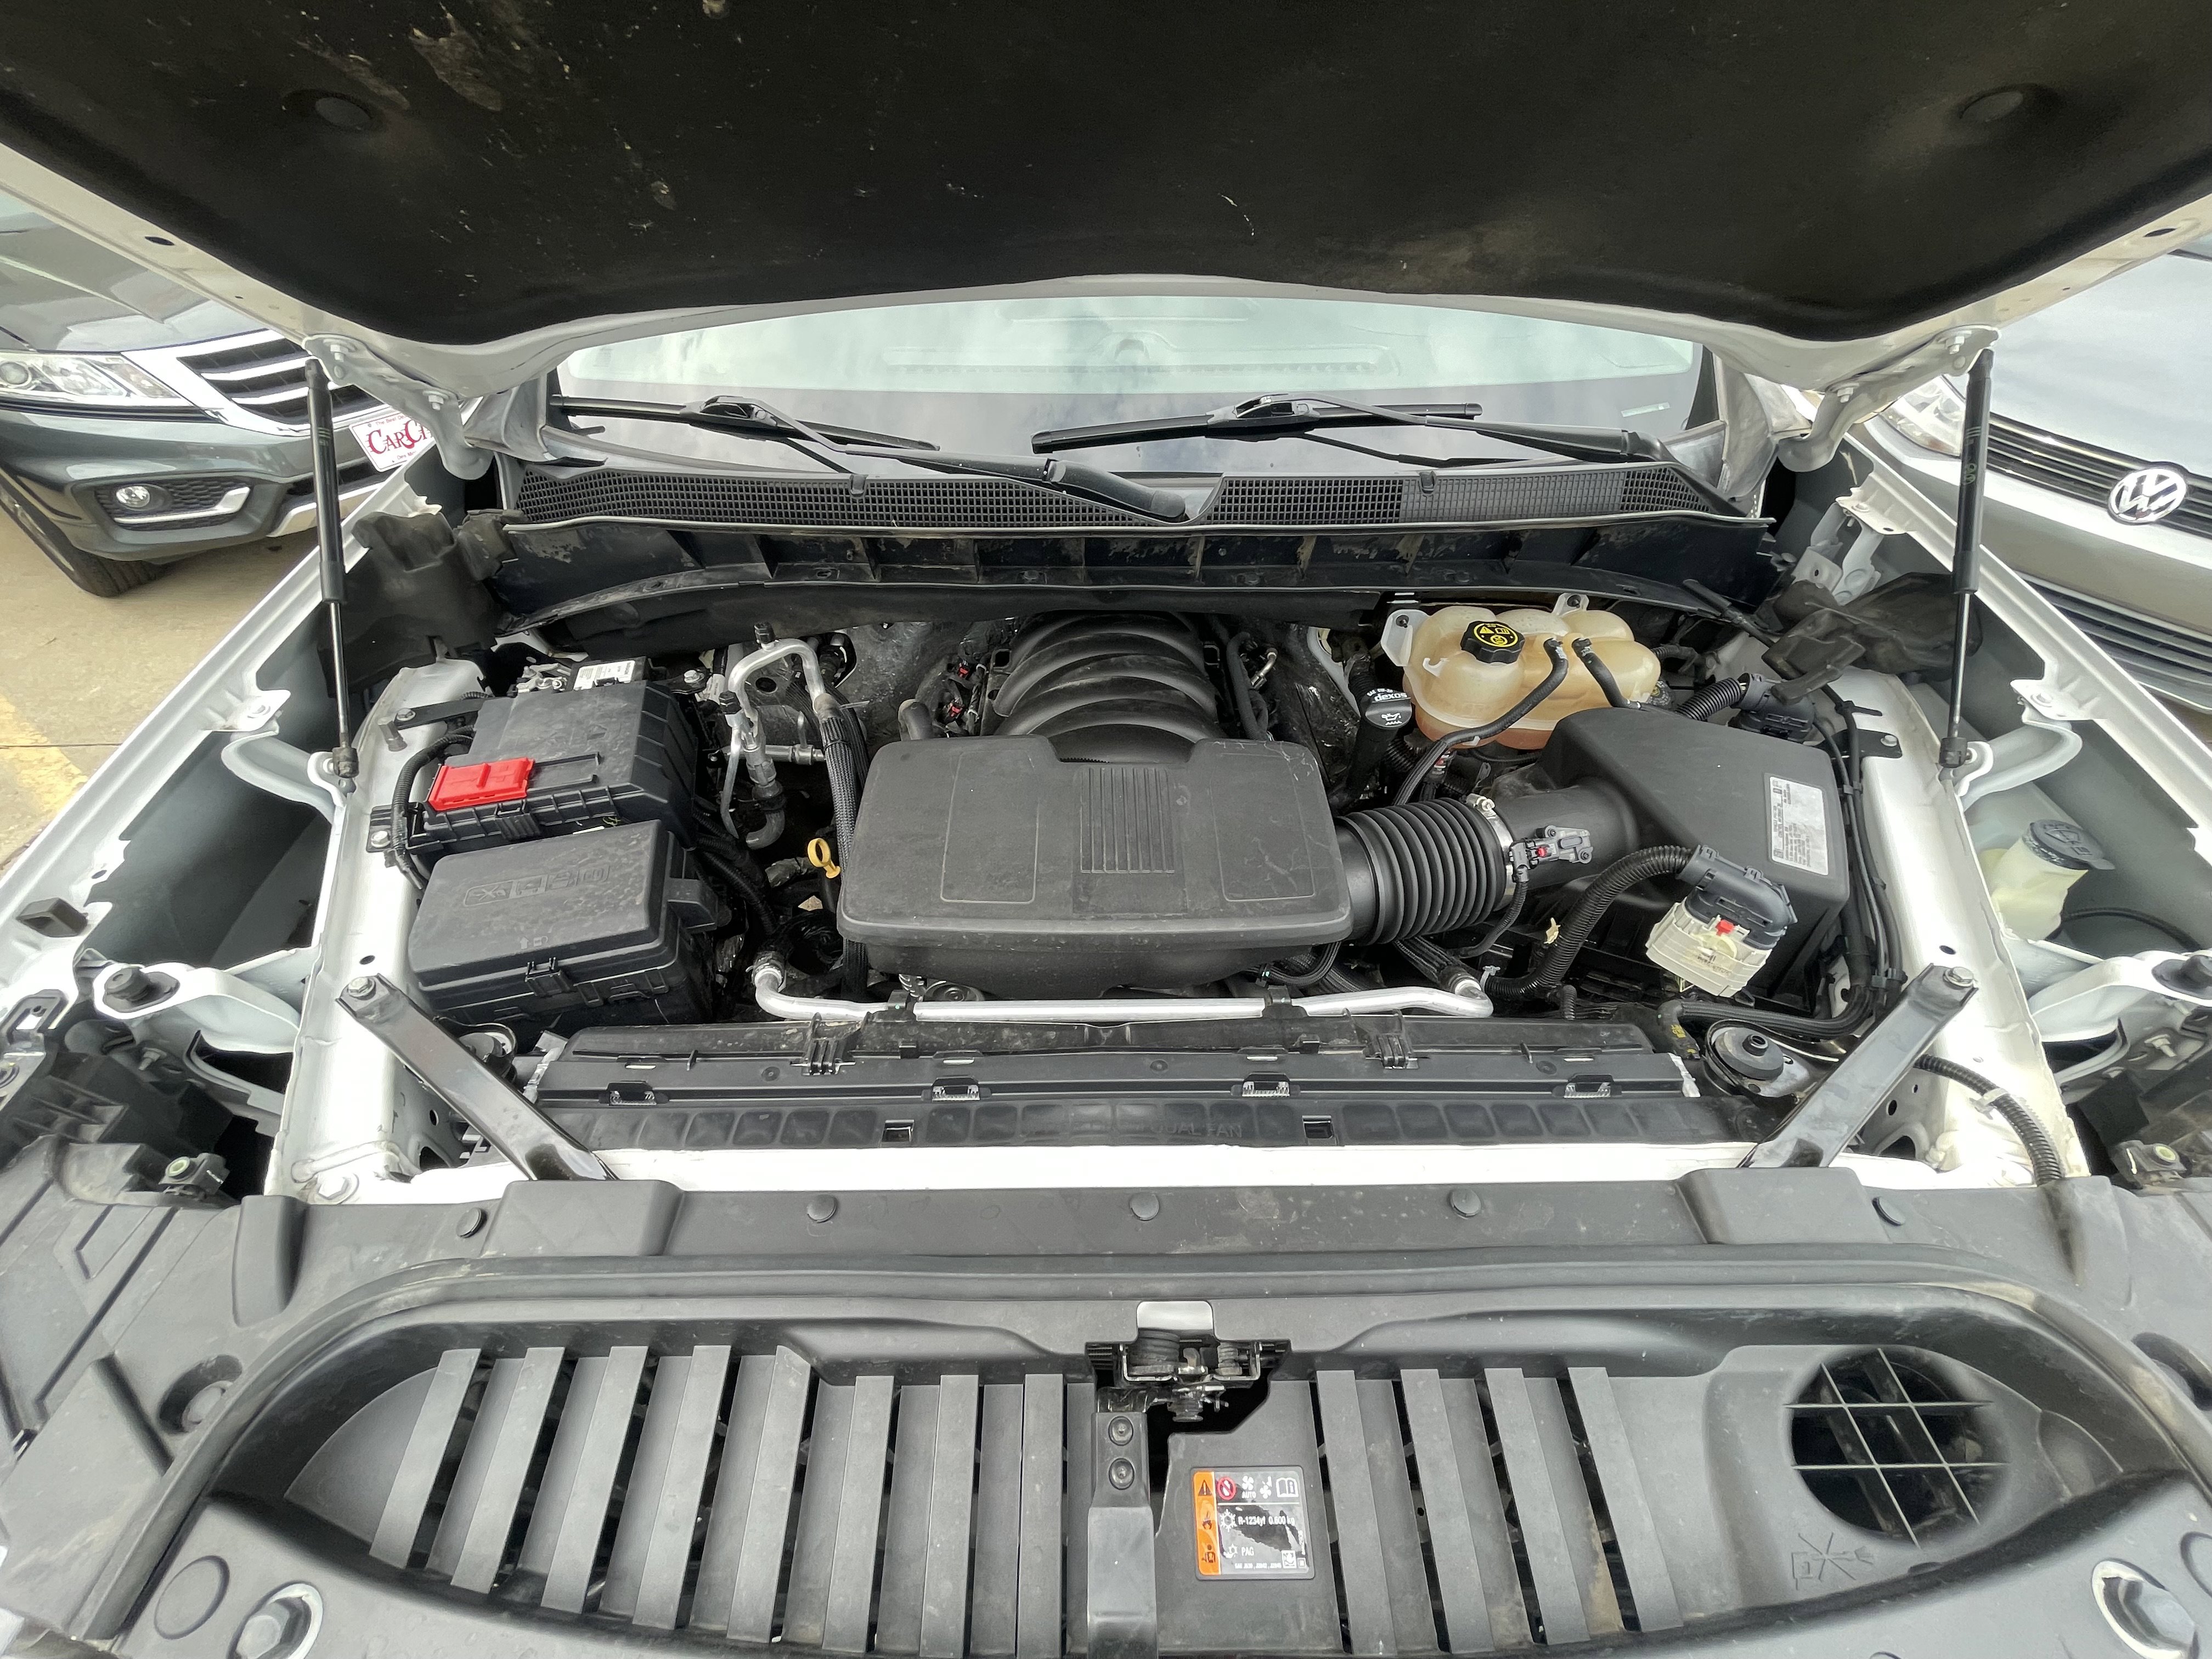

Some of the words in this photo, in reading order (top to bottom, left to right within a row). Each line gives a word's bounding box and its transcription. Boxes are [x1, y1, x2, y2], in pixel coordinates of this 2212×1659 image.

[1374, 693, 1407, 702] dexos
[1207, 1124, 1242, 1137] FAN
[1242, 1491, 1256, 1499] AUTO
[1268, 1515, 1286, 1525] 0.600
[1286, 1516, 1295, 1526] kg
[1241, 1547, 1255, 1556] PAG
